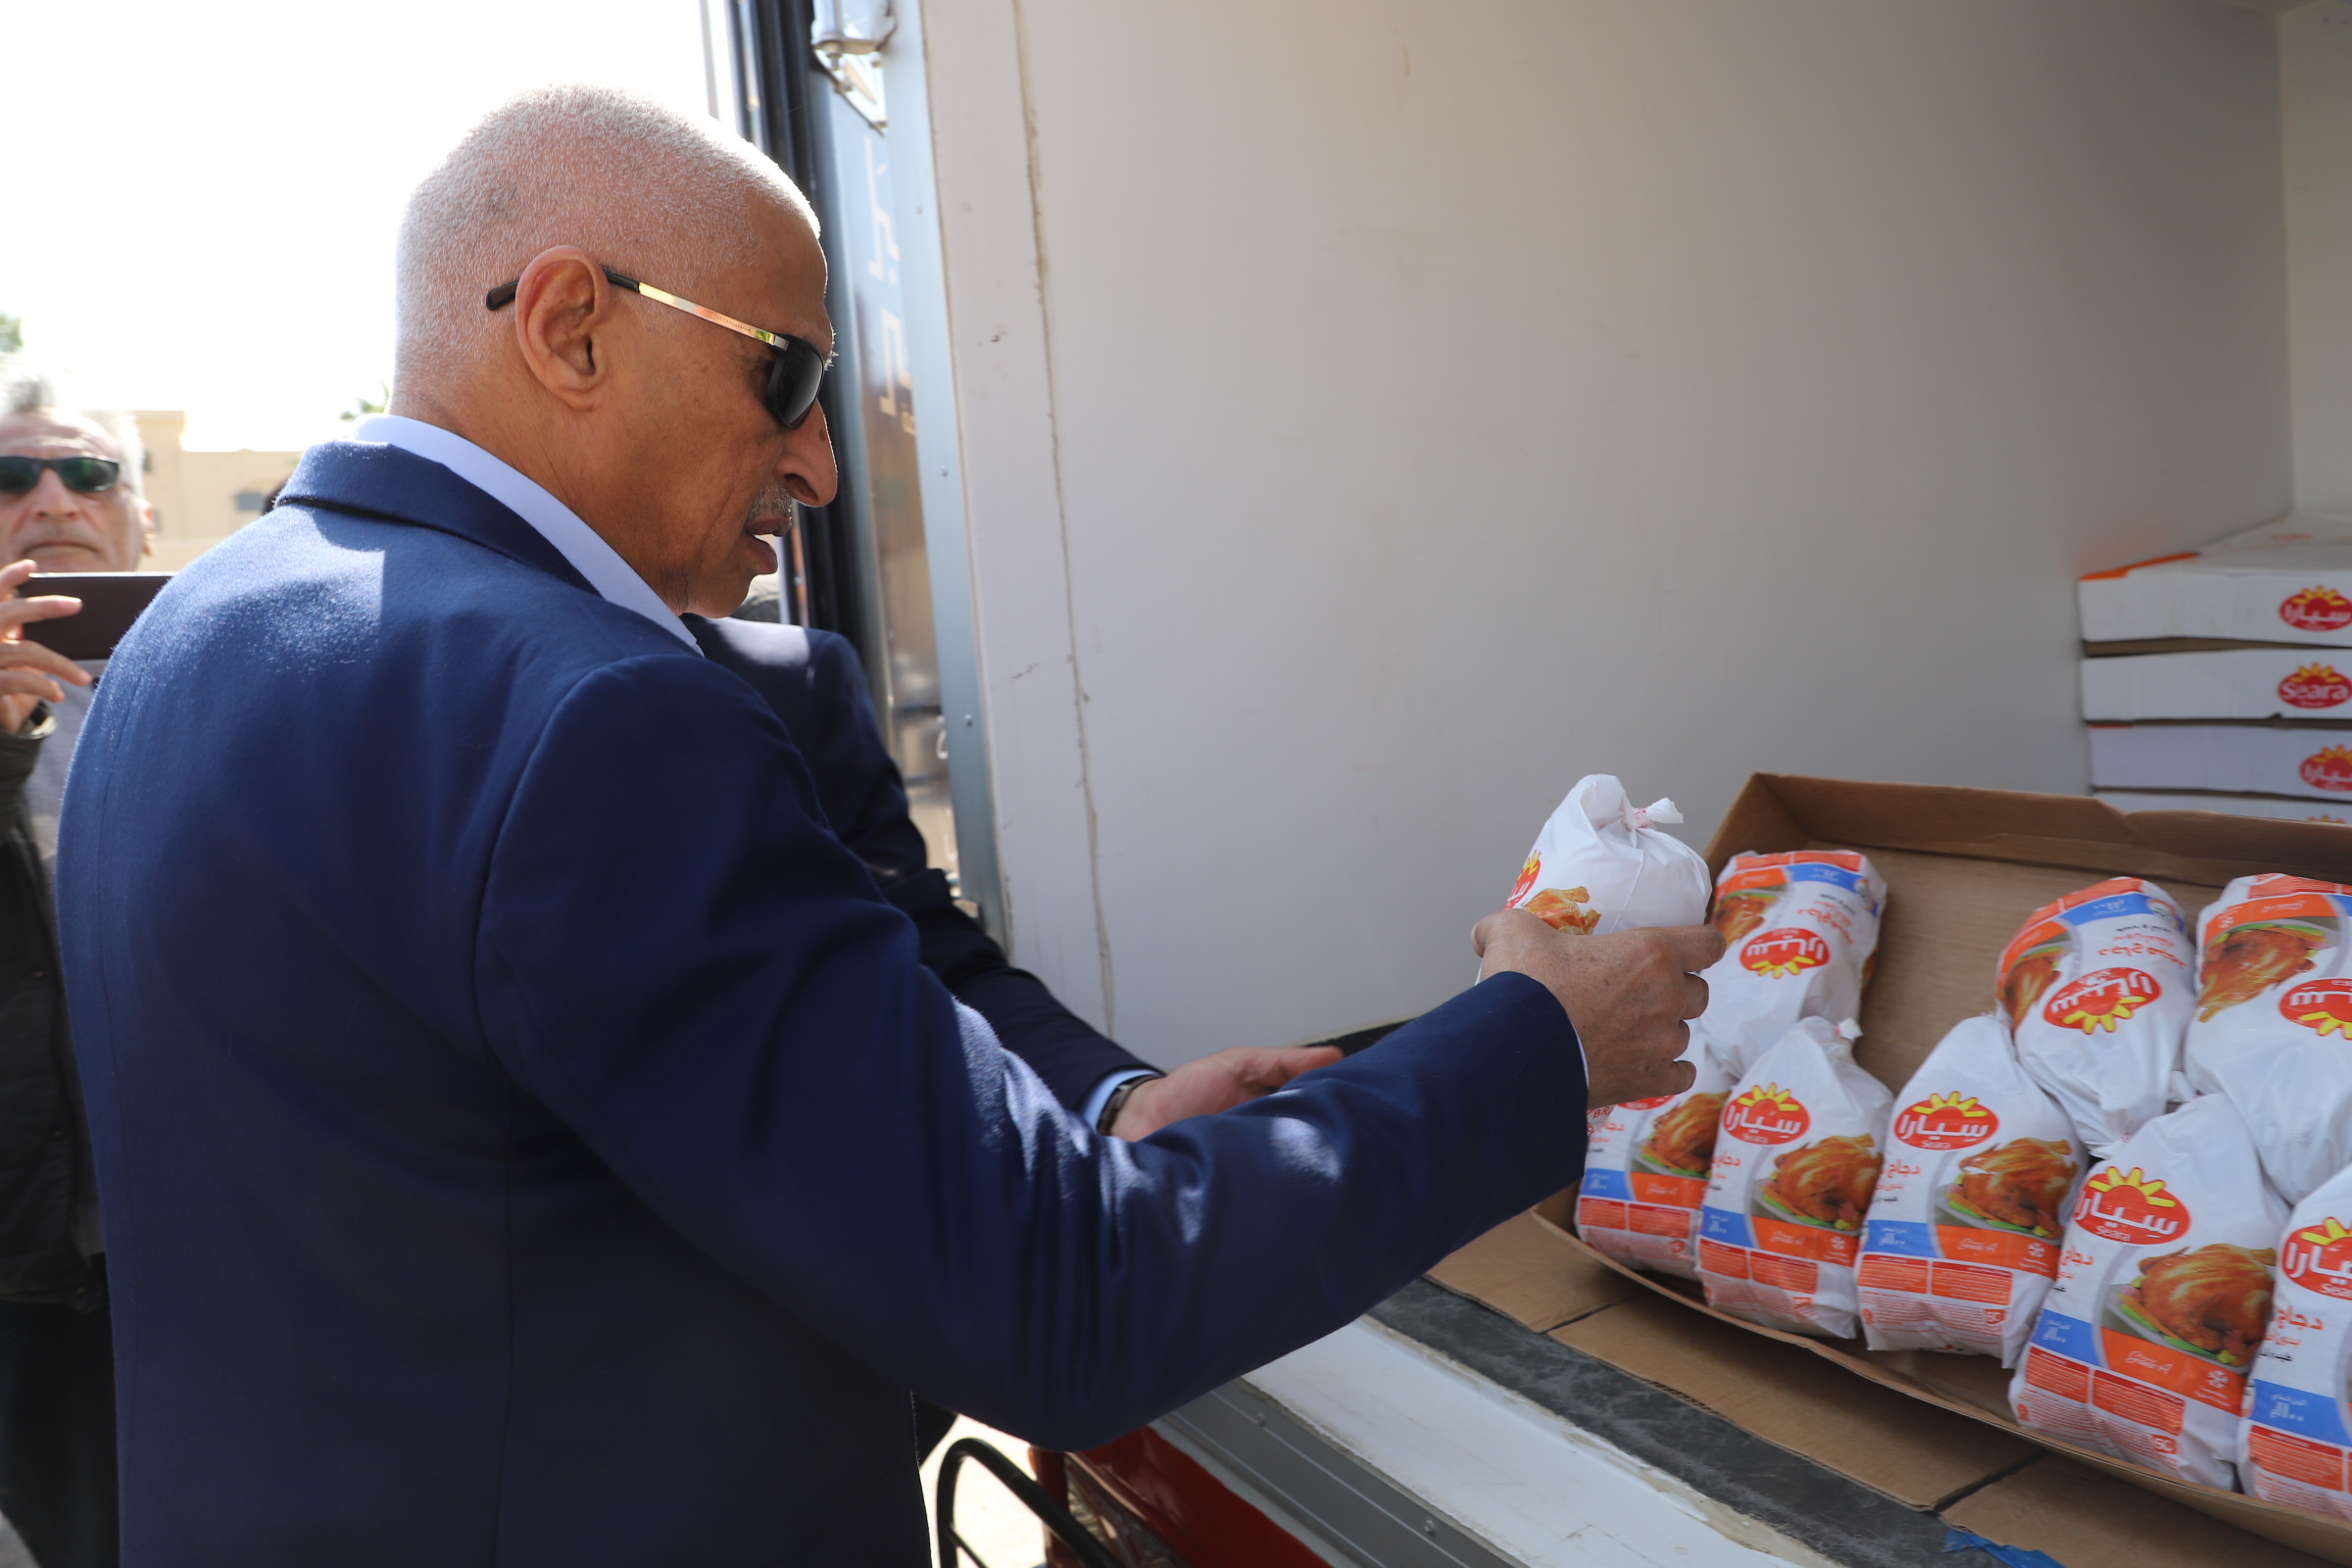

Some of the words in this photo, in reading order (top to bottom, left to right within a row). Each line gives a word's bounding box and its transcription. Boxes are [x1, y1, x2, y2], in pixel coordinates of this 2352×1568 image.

[2281, 682, 2348, 700] Seara
[1921, 1140, 1952, 1150] Seara
[2095, 1225, 2132, 1242] Seara
